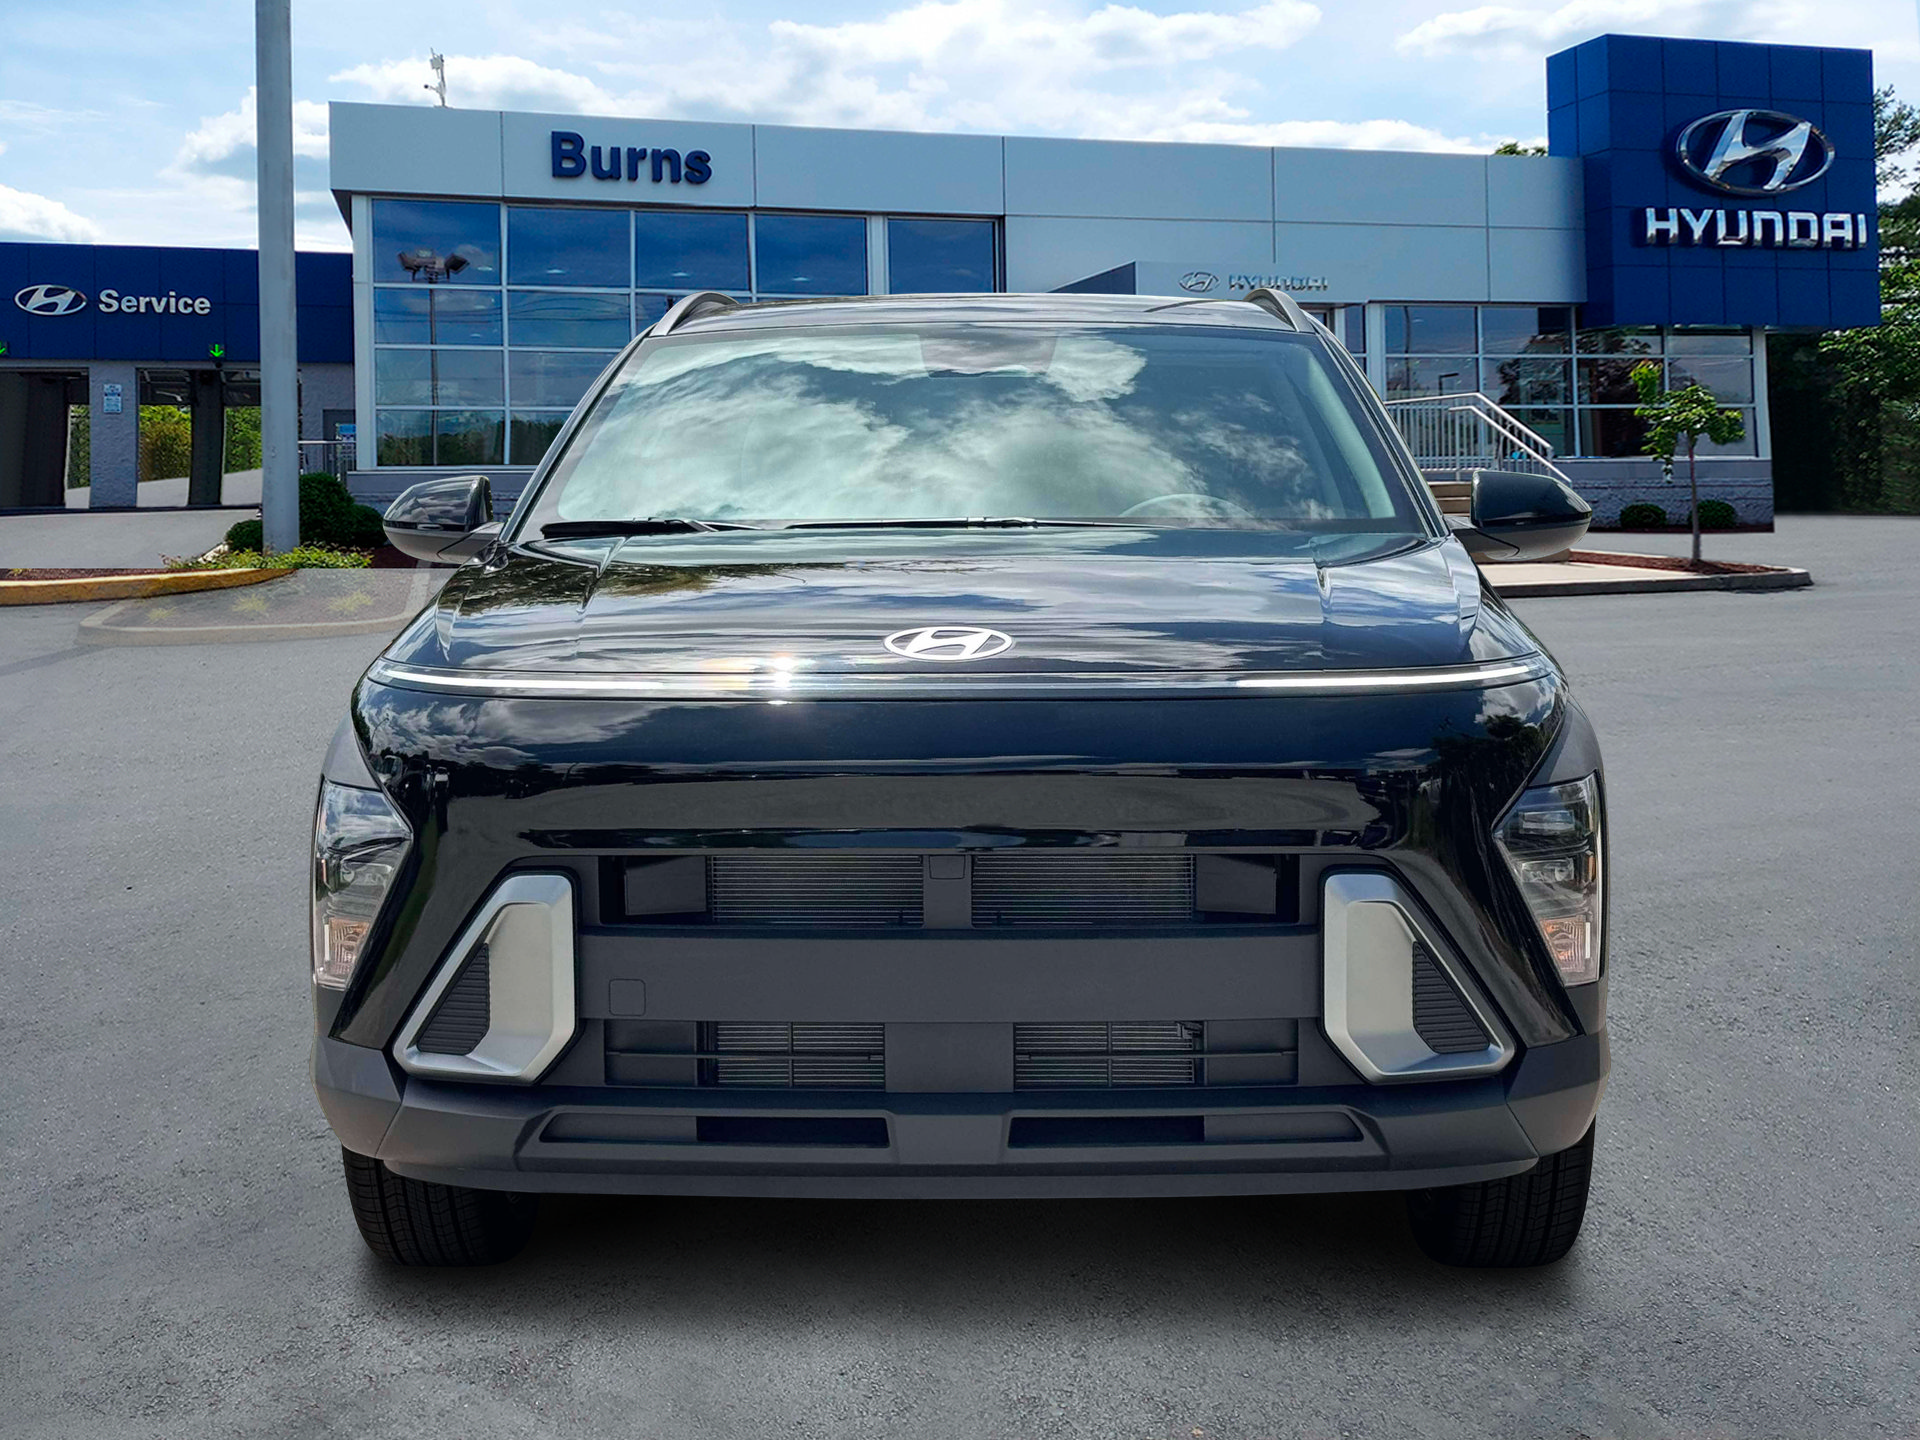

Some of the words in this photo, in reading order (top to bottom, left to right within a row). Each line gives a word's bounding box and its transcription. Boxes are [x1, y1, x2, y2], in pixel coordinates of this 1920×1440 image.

[551, 131, 713, 184] Burns
[1645, 207, 1867, 248] HYUNDAI
[1228, 274, 1328, 290] HYUNDAI
[98, 289, 212, 315] Service
